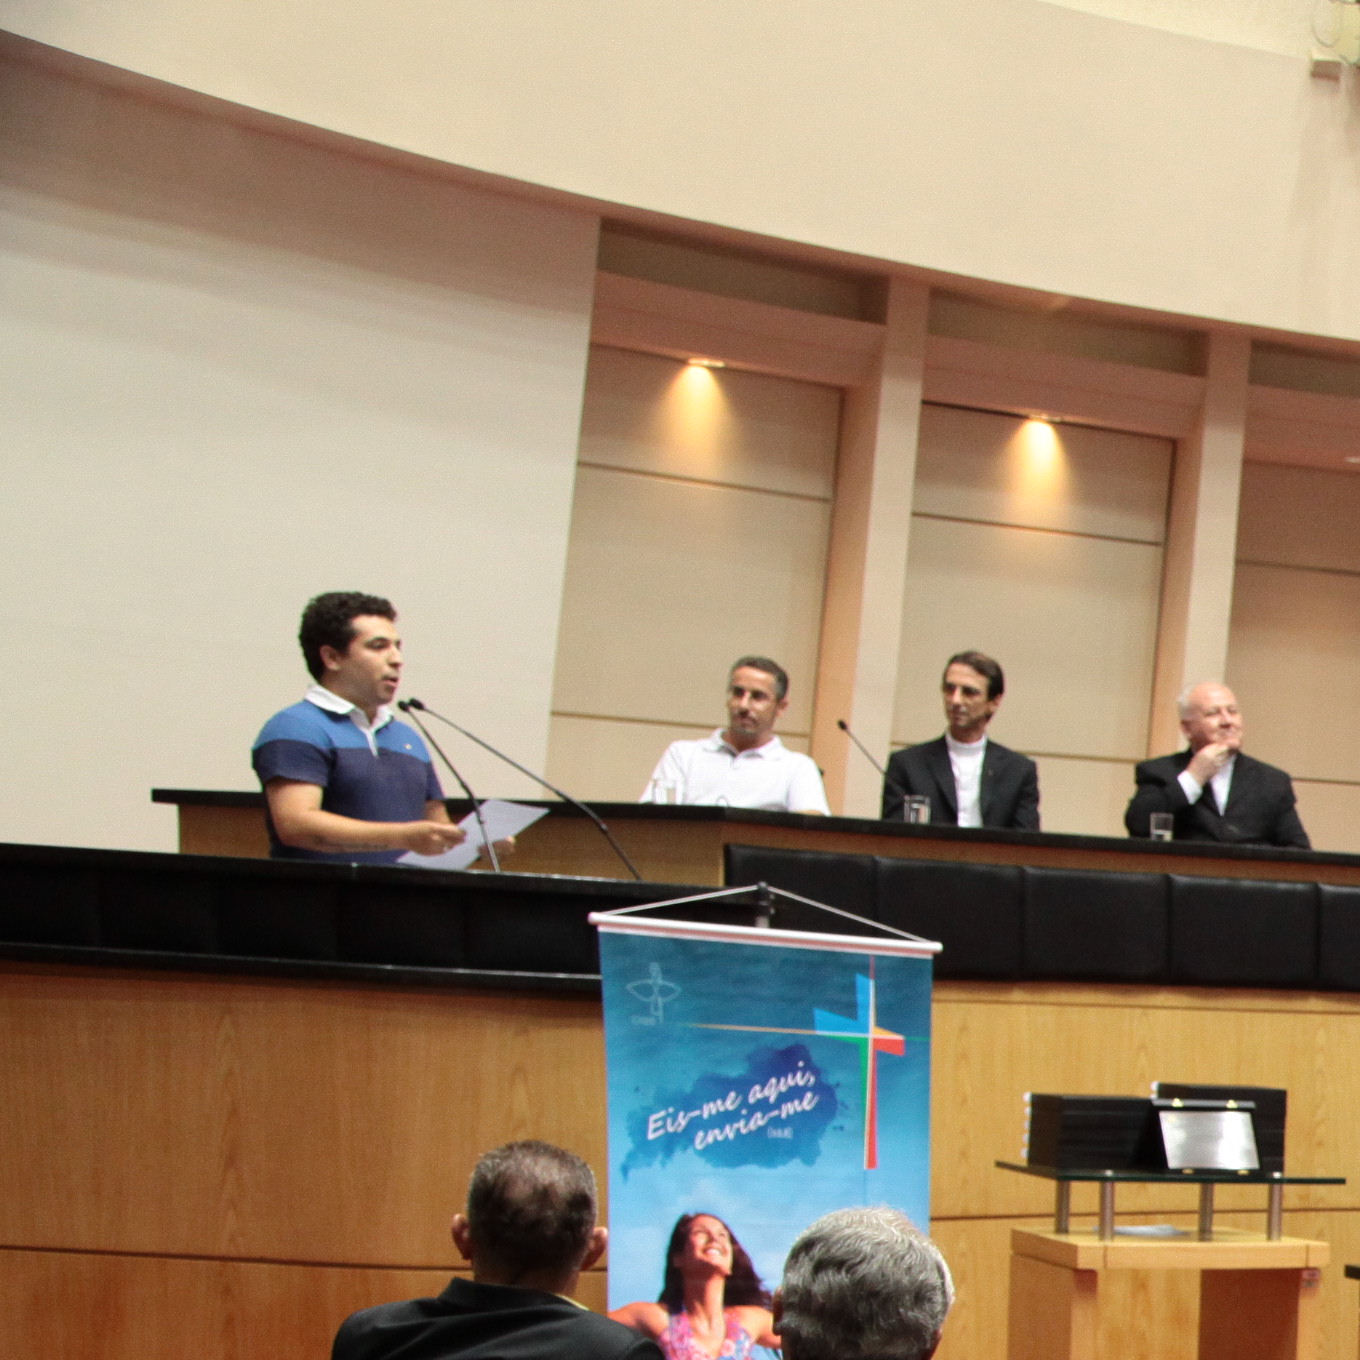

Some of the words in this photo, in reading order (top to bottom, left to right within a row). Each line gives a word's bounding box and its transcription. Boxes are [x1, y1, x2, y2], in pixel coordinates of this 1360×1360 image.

[646, 1090, 742, 1141] Eis-me
[747, 1060, 816, 1105] aqui,
[693, 1091, 820, 1150] envia-me
